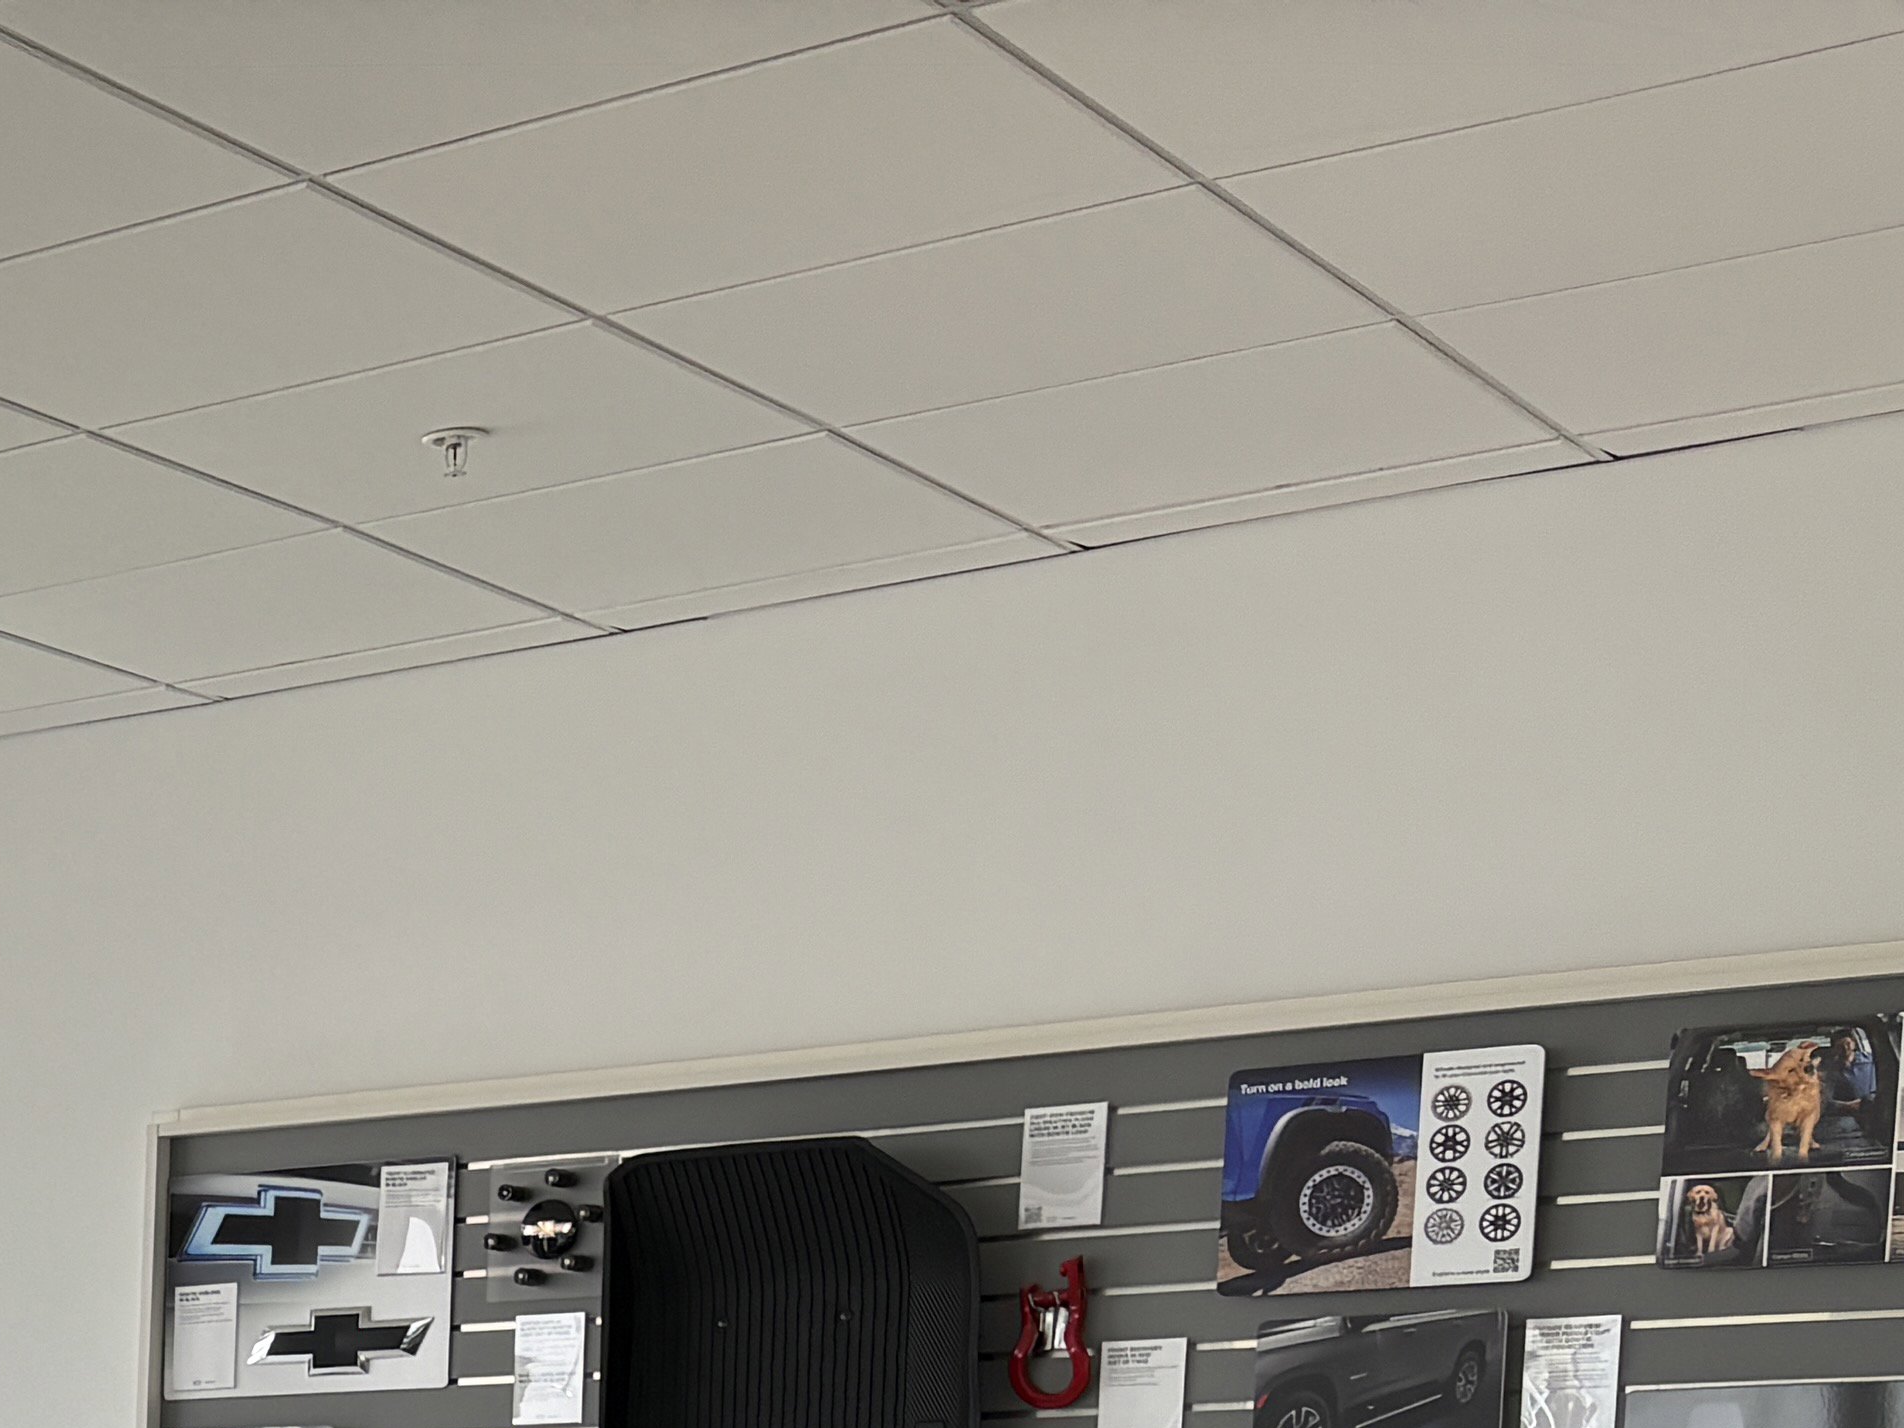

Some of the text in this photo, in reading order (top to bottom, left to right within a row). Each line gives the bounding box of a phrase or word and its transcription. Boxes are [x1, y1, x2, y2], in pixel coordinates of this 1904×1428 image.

[1240, 1076, 1349, 1094] Turn on a bold look
